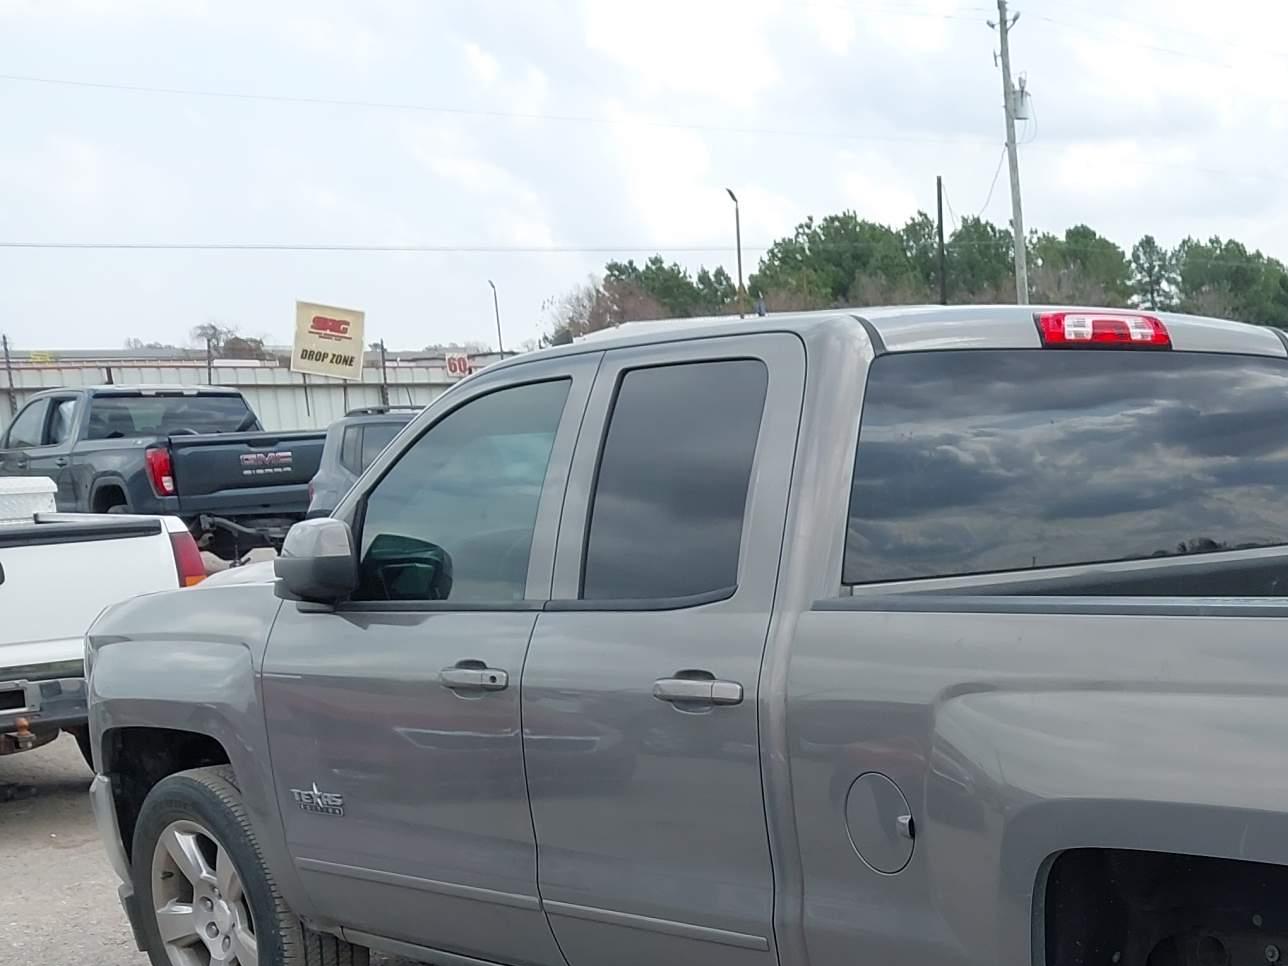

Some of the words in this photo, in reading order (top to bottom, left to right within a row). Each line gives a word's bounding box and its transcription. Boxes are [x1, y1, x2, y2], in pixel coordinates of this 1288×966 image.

[300, 349, 329, 363] DROP
[329, 352, 355, 367] ZONE
[447, 357, 467, 373] 60
[289, 782, 343, 807] TEXAS
